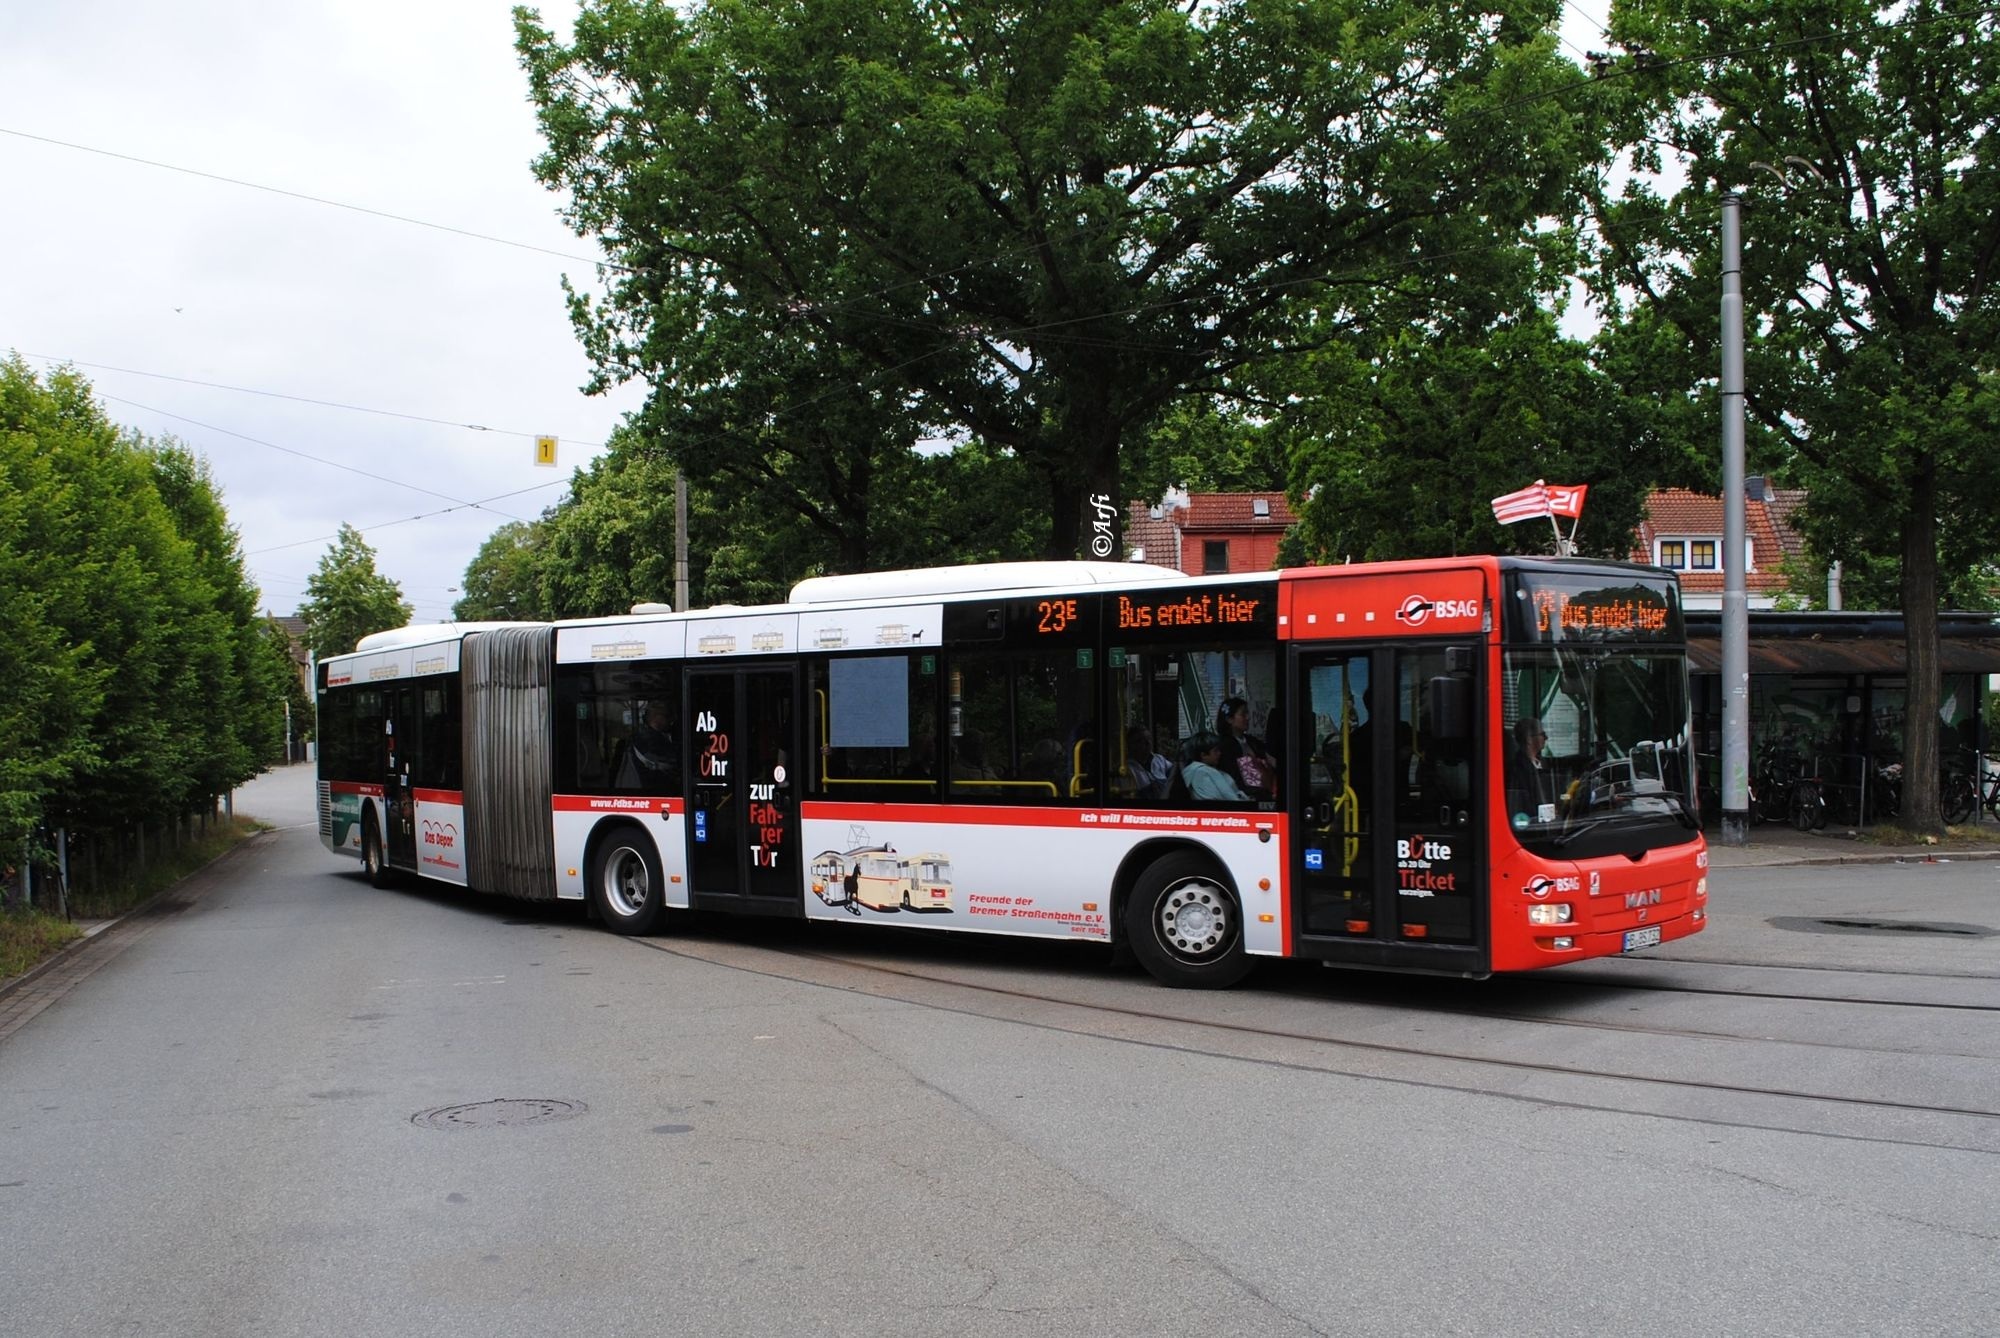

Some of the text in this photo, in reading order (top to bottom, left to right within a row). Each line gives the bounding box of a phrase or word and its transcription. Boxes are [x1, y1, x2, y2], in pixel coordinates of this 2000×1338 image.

[542, 443, 548, 458] 1
[1119, 594, 1259, 628] Bus endet hier
[1435, 600, 1478, 618] BSAG
[1560, 592, 1587, 629] Bus
[1592, 600, 1633, 628] endet
[1638, 600, 1667, 629] hier
[696, 711, 717, 732] Ab
[709, 734, 728, 753] 20
[750, 784, 775, 800] zur
[590, 798, 651, 809] www.fdbs.net
[750, 803, 783, 825] Fah-
[1081, 813, 1098, 823] Ich
[1100, 813, 1120, 823] will
[1122, 814, 1198, 826] Museumsbus
[1200, 817, 1250, 828] werden.
[761, 826, 783, 844] rer
[1398, 869, 1456, 891] Ticket
[1556, 877, 1580, 892] BSAG
[969, 894, 1033, 906] Freunde der
[1624, 888, 1661, 909] MAN
[969, 906, 1008, 916] Bremer
[1011, 908, 1082, 922] Straßenbahn
[1085, 914, 1105, 924] e.V.
